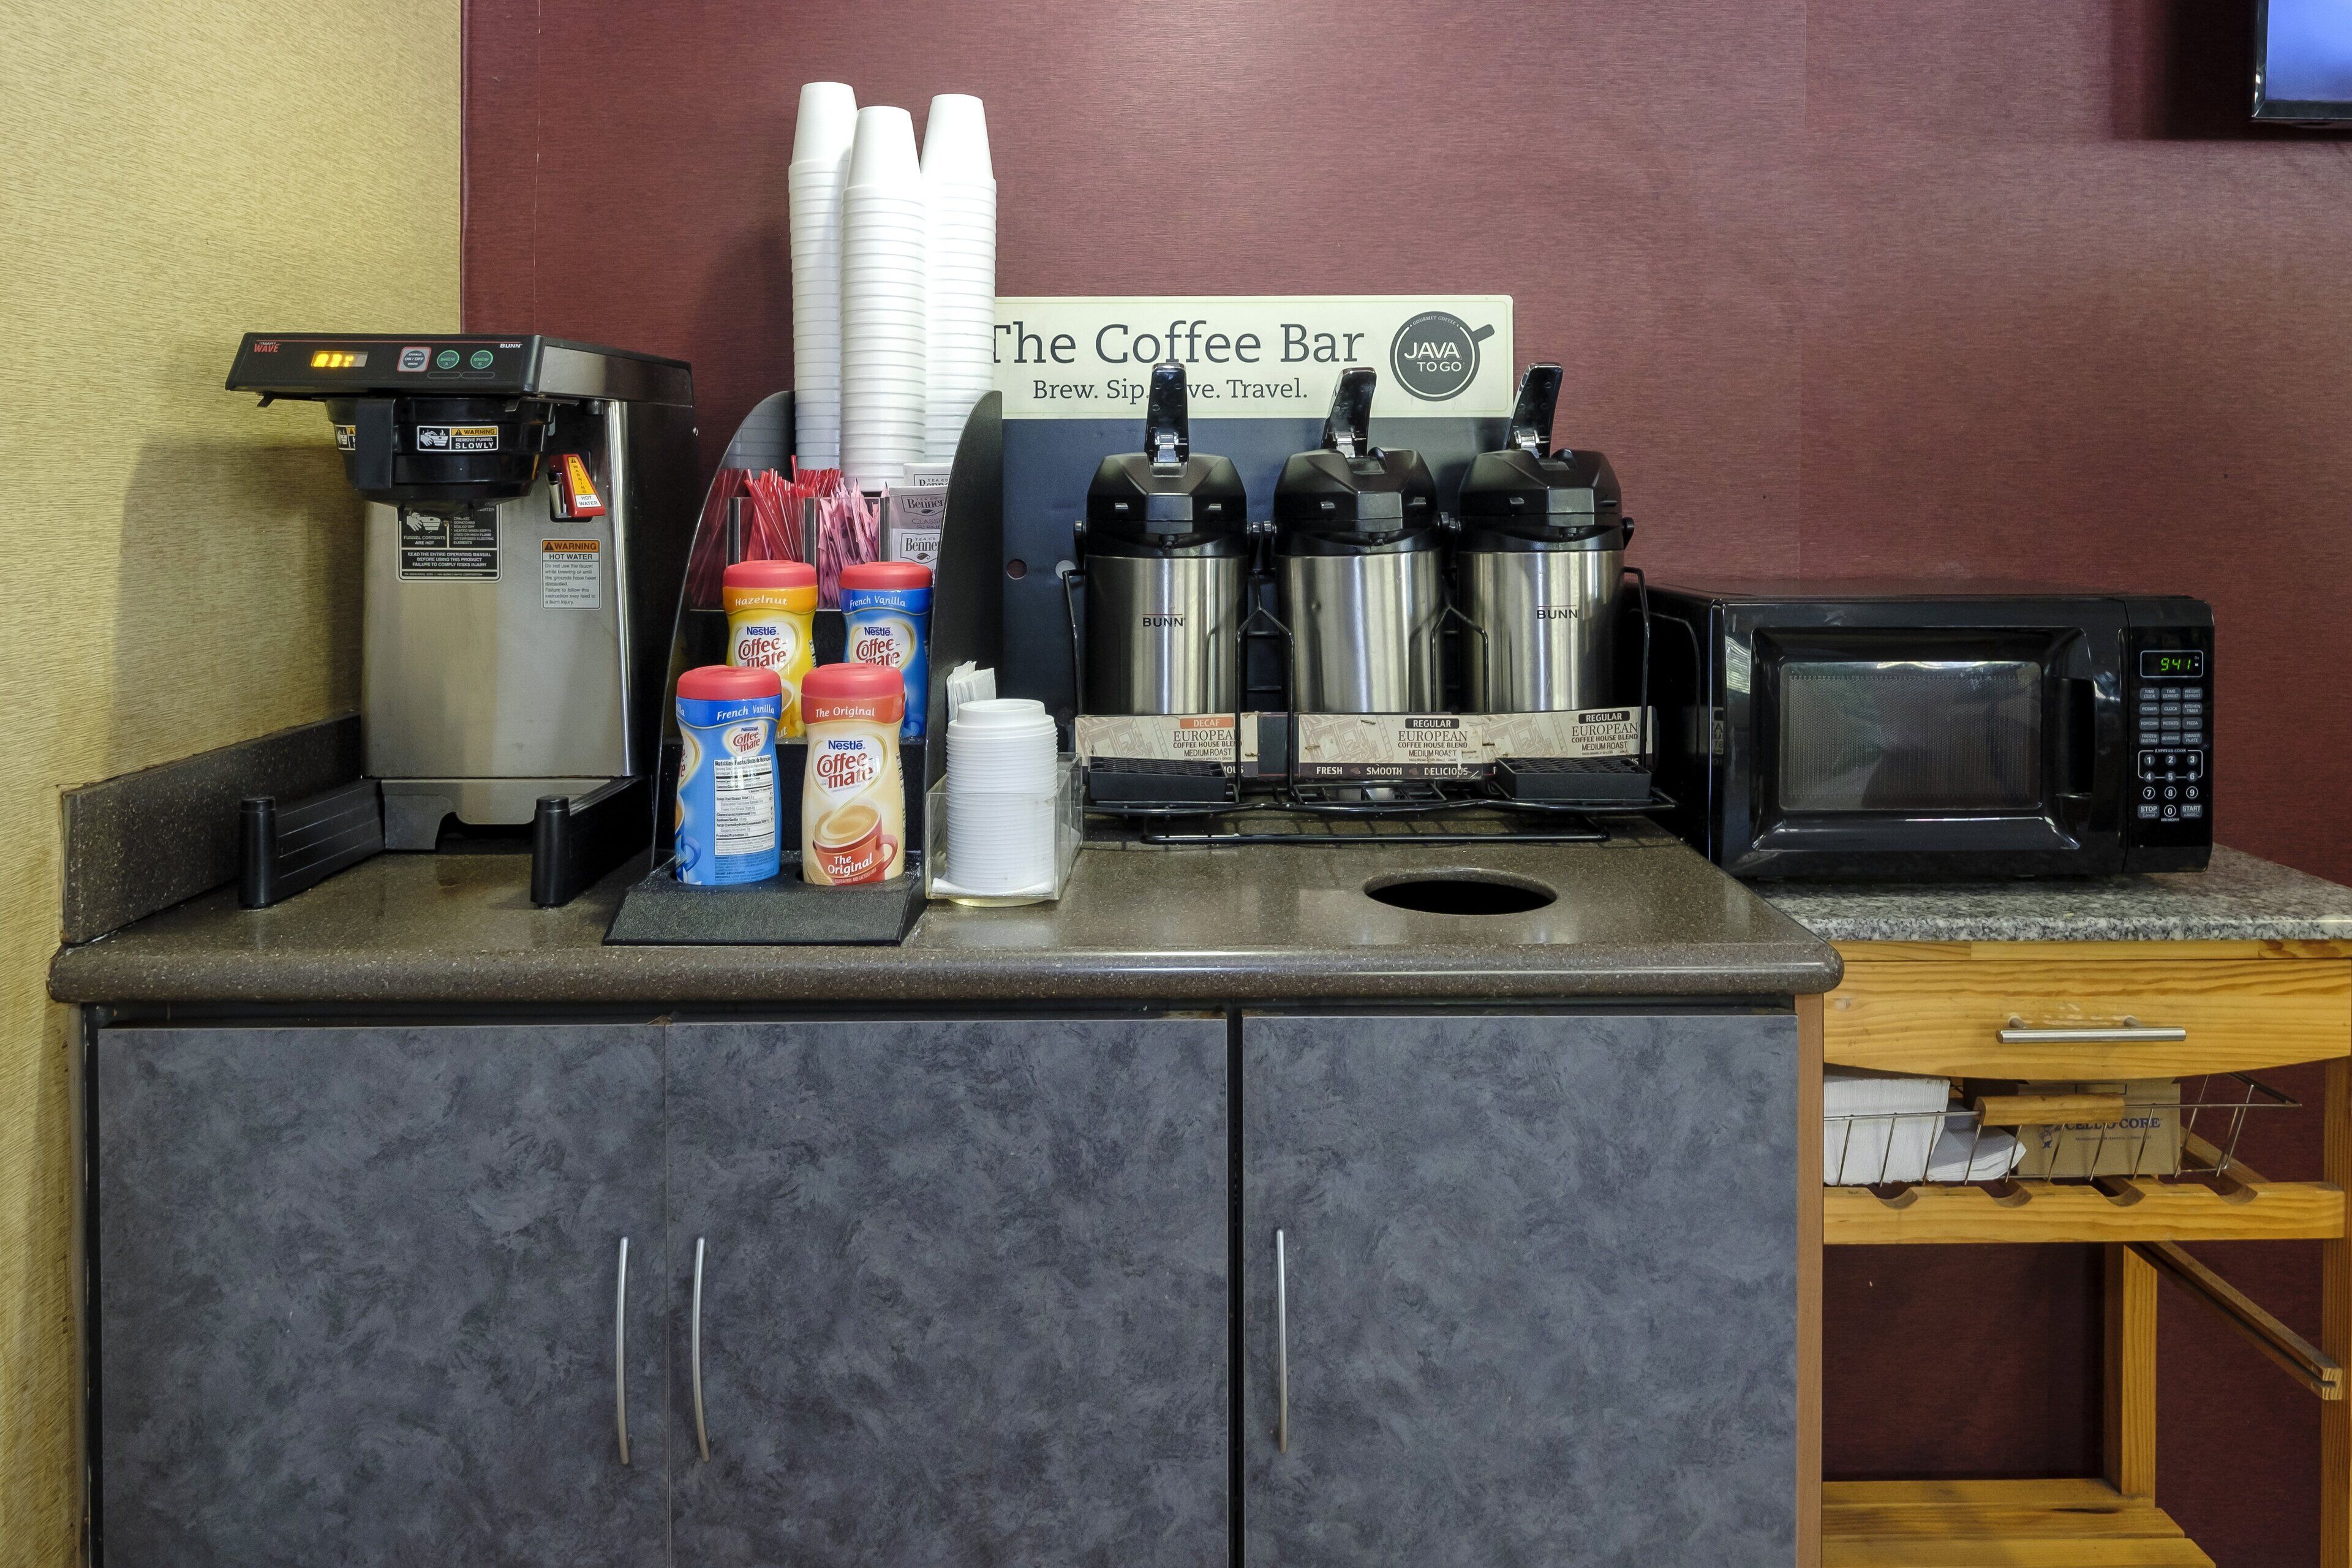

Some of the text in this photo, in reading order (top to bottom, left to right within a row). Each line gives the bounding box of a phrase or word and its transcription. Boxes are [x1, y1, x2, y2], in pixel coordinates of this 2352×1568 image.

[1413, 315, 1457, 325] GOURMET COFFEE
[1096, 320, 1261, 363] Coffee
[1280, 323, 1365, 363] Bar
[254, 343, 281, 353] WAVE
[1404, 342, 1462, 360] JAVA
[1417, 361, 1462, 372] TO GO
[1033, 380, 1098, 399] Brew.
[1107, 378, 1149, 405] Sip.
[1226, 378, 1308, 398] Travel.
[906, 538, 939, 552] Benne
[735, 595, 788, 606] Hazelnut
[850, 595, 907, 609] French Vanilla
[1537, 609, 1578, 619] BUNN
[1142, 617, 1183, 627] BUNN
[717, 704, 775, 721] French Vanilla
[815, 706, 875, 718] The Original
[1586, 712, 1622, 722] REGULAR
[1193, 718, 1221, 727] DECAF
[1413, 719, 1451, 728] REGULAR
[1572, 723, 1638, 736] EUROPEAN
[1398, 730, 1468, 742] EUROPEAN
[740, 737, 761, 752] mate
[1316, 766, 1468, 775] FRESH SMOOTH DELICIOUS
[828, 767, 873, 789] mate
[827, 852, 873, 877] Original
[834, 855, 851, 865] The
